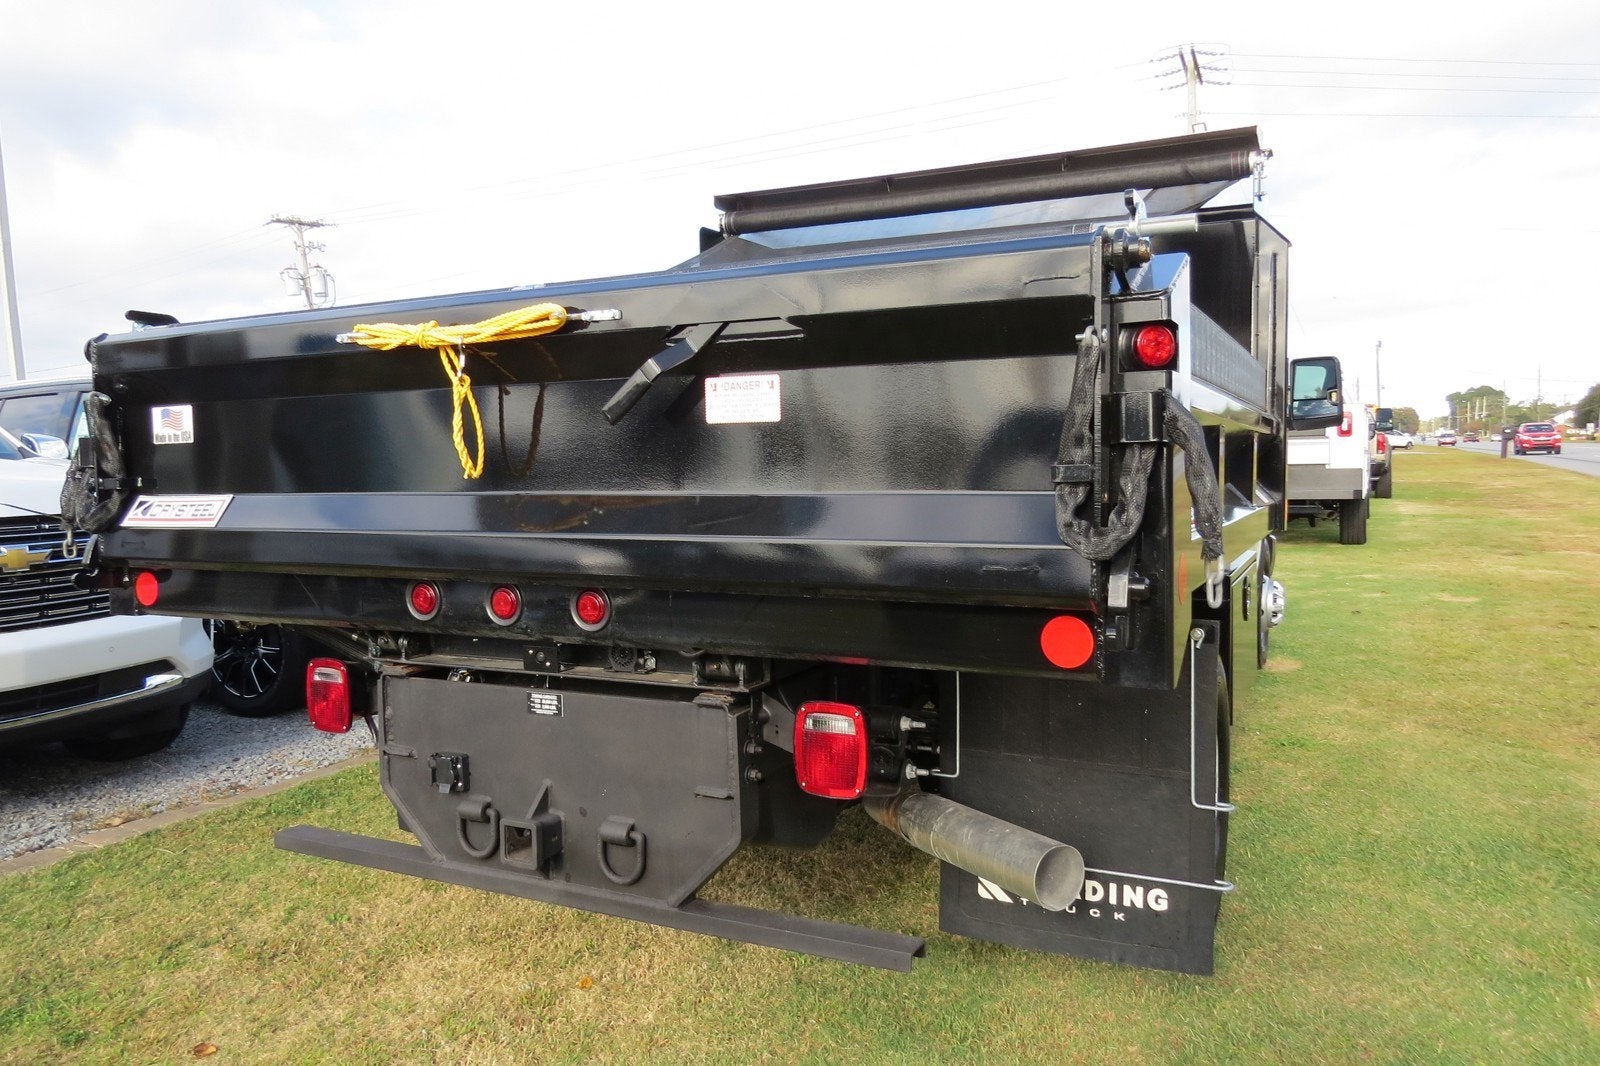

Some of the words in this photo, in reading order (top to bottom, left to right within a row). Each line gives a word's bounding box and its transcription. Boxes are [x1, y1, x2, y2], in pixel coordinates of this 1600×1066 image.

[155, 433, 167, 443] Made
[181, 430, 191, 442] USA
[1077, 879, 1169, 912] DING
[1017, 896, 1126, 922] TUCK
